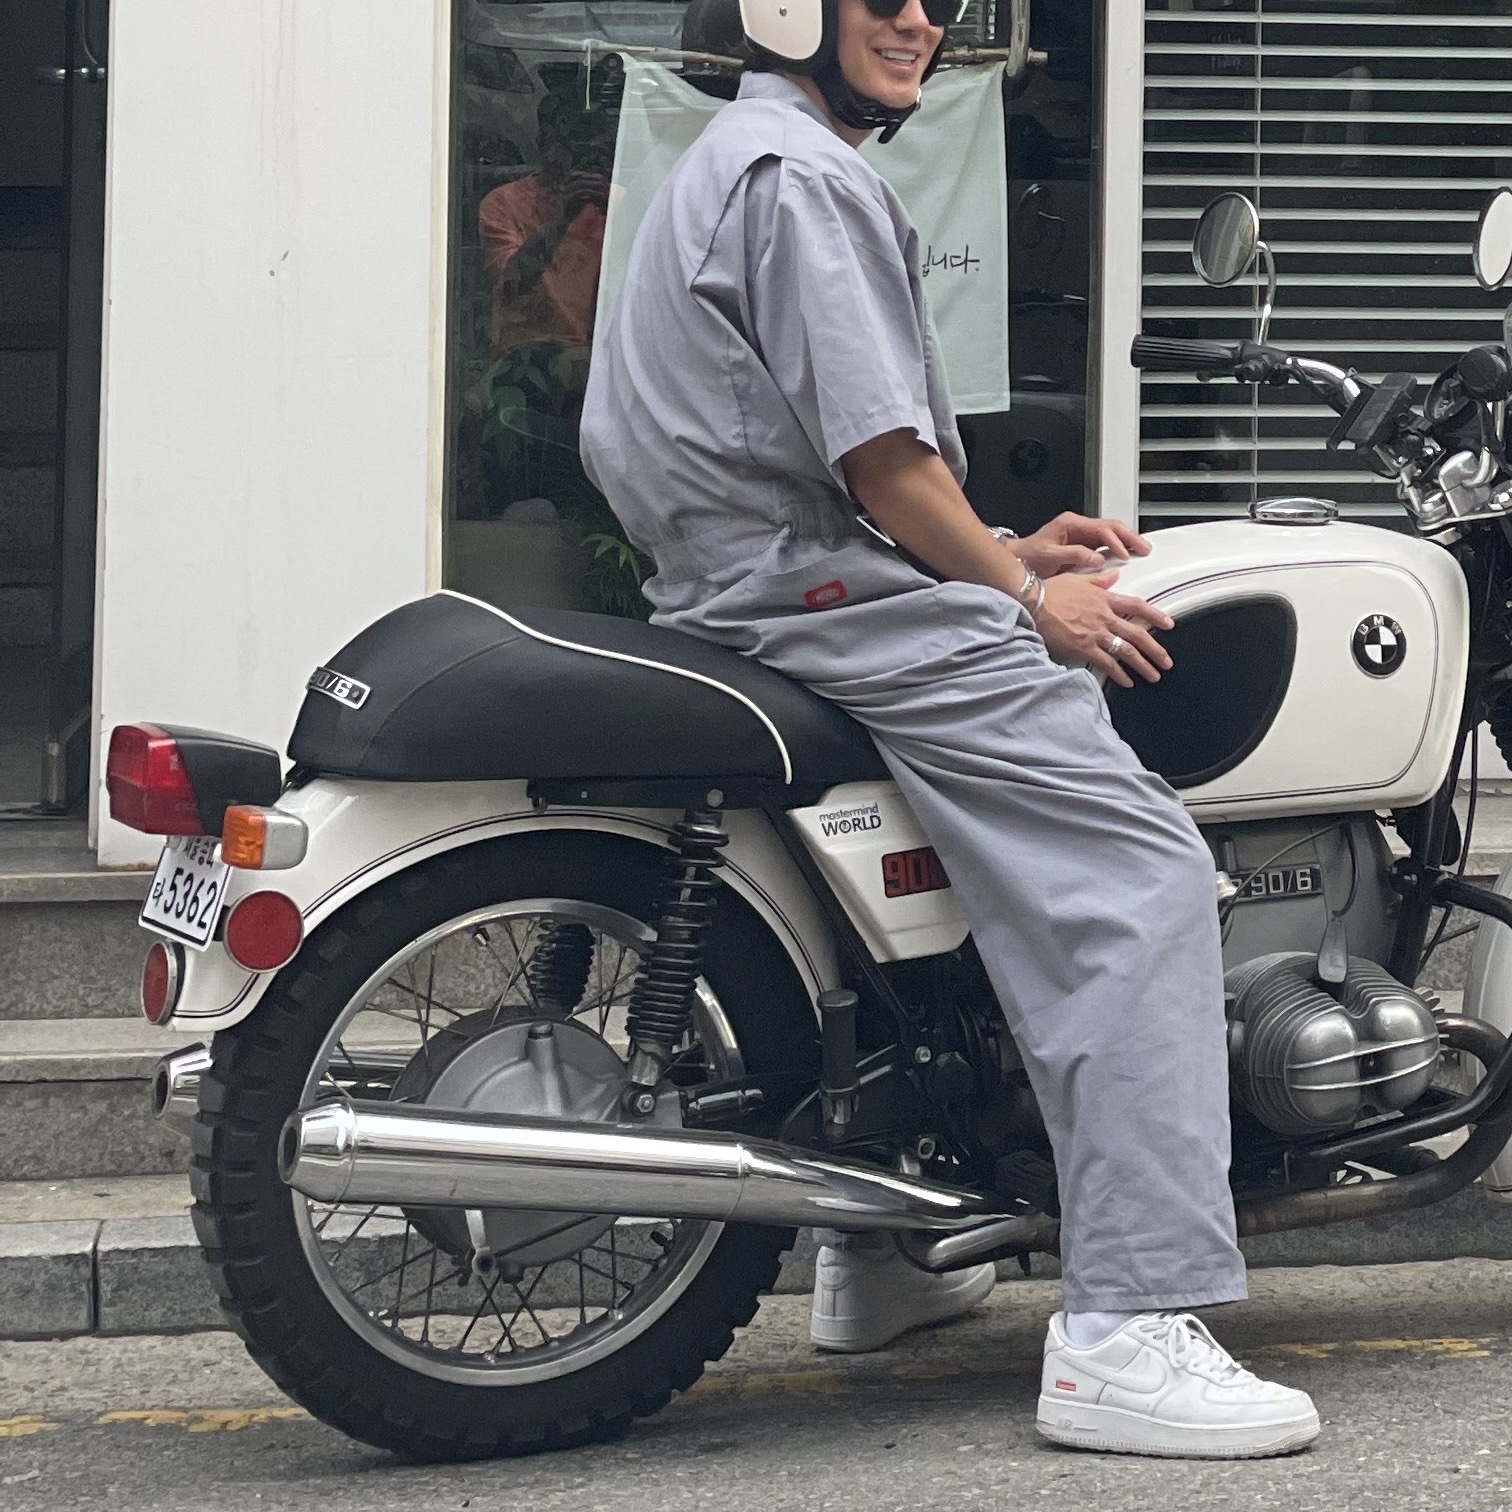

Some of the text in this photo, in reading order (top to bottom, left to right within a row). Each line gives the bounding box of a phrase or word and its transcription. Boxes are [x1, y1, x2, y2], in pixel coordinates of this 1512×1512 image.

[1358, 615, 1402, 637] BMW
[821, 815, 882, 837] WORLD
[164, 867, 217, 930] 5362
